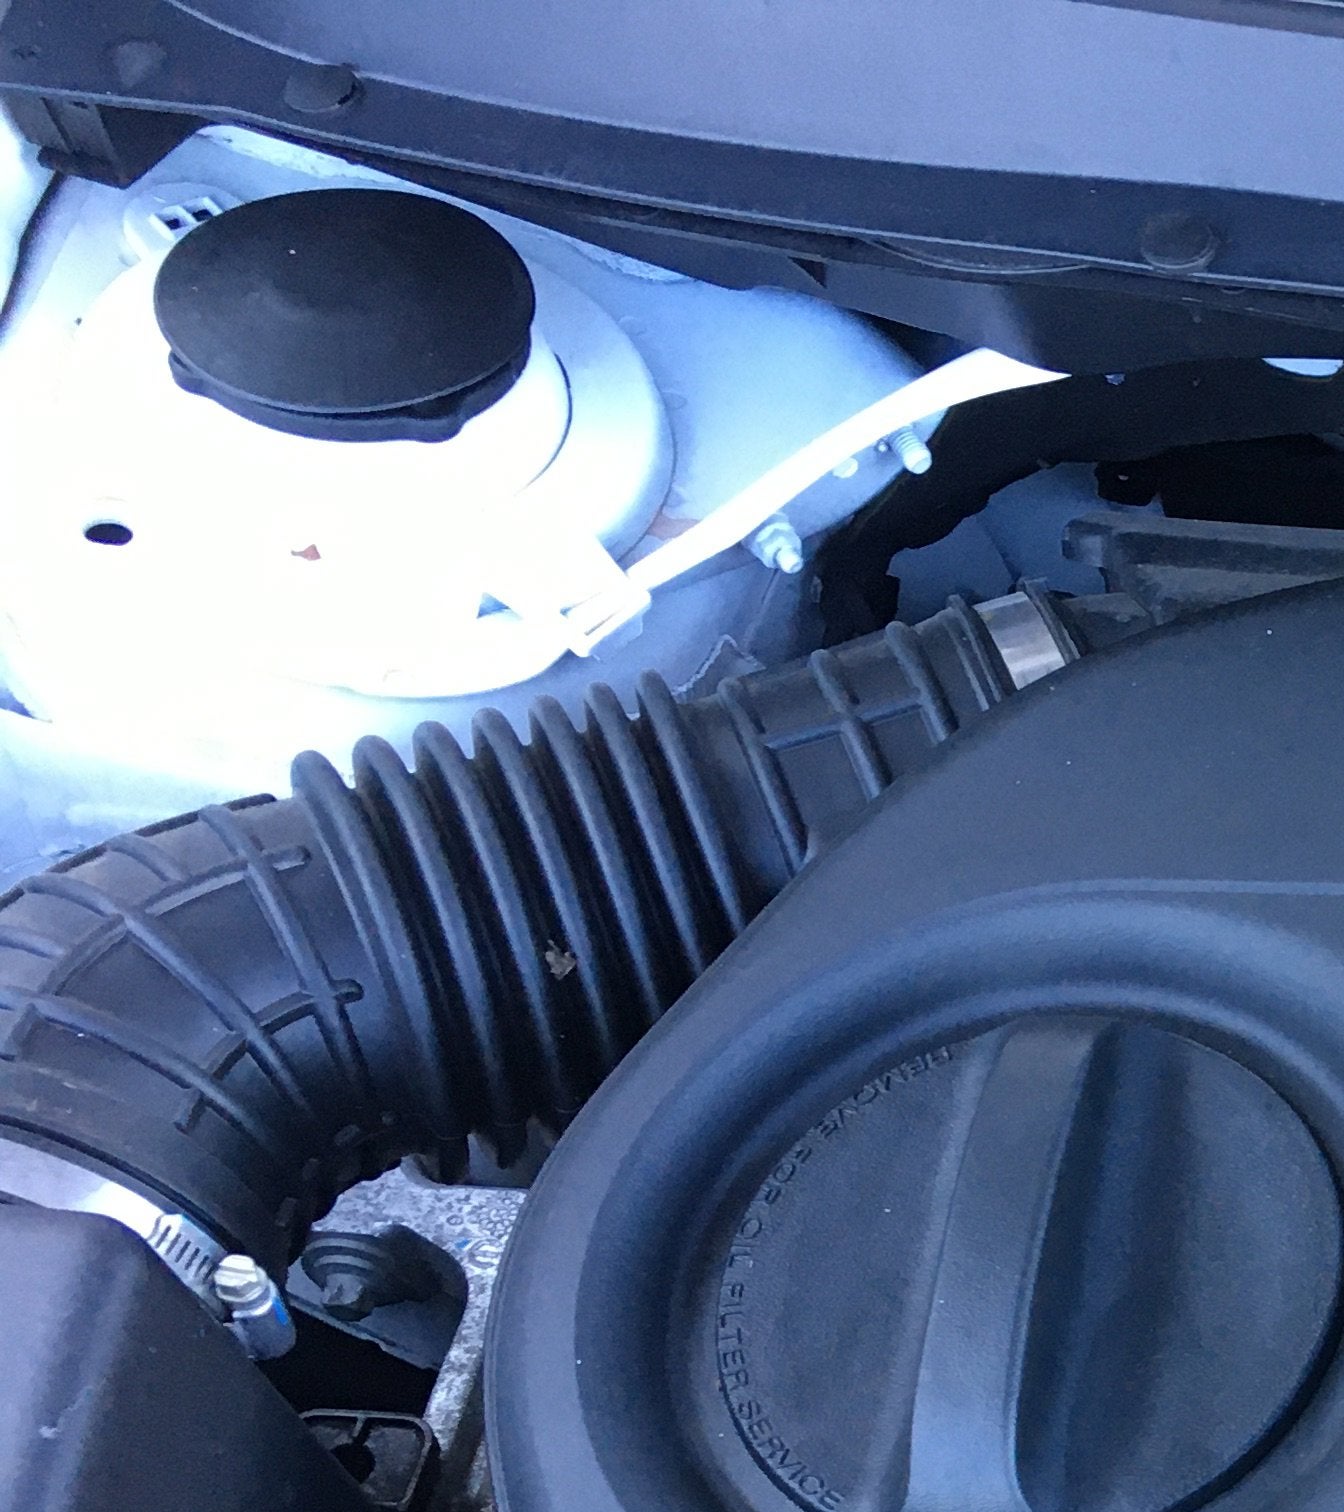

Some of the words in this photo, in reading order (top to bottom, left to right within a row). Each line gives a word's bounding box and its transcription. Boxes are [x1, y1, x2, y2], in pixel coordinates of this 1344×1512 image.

[815, 1046, 952, 1138] REMOVE
[762, 1147, 813, 1205] FOR
[728, 1218, 762, 1268] OIL
[719, 1282, 749, 1391] FILTER
[737, 1399, 846, 1511] SERVICE
